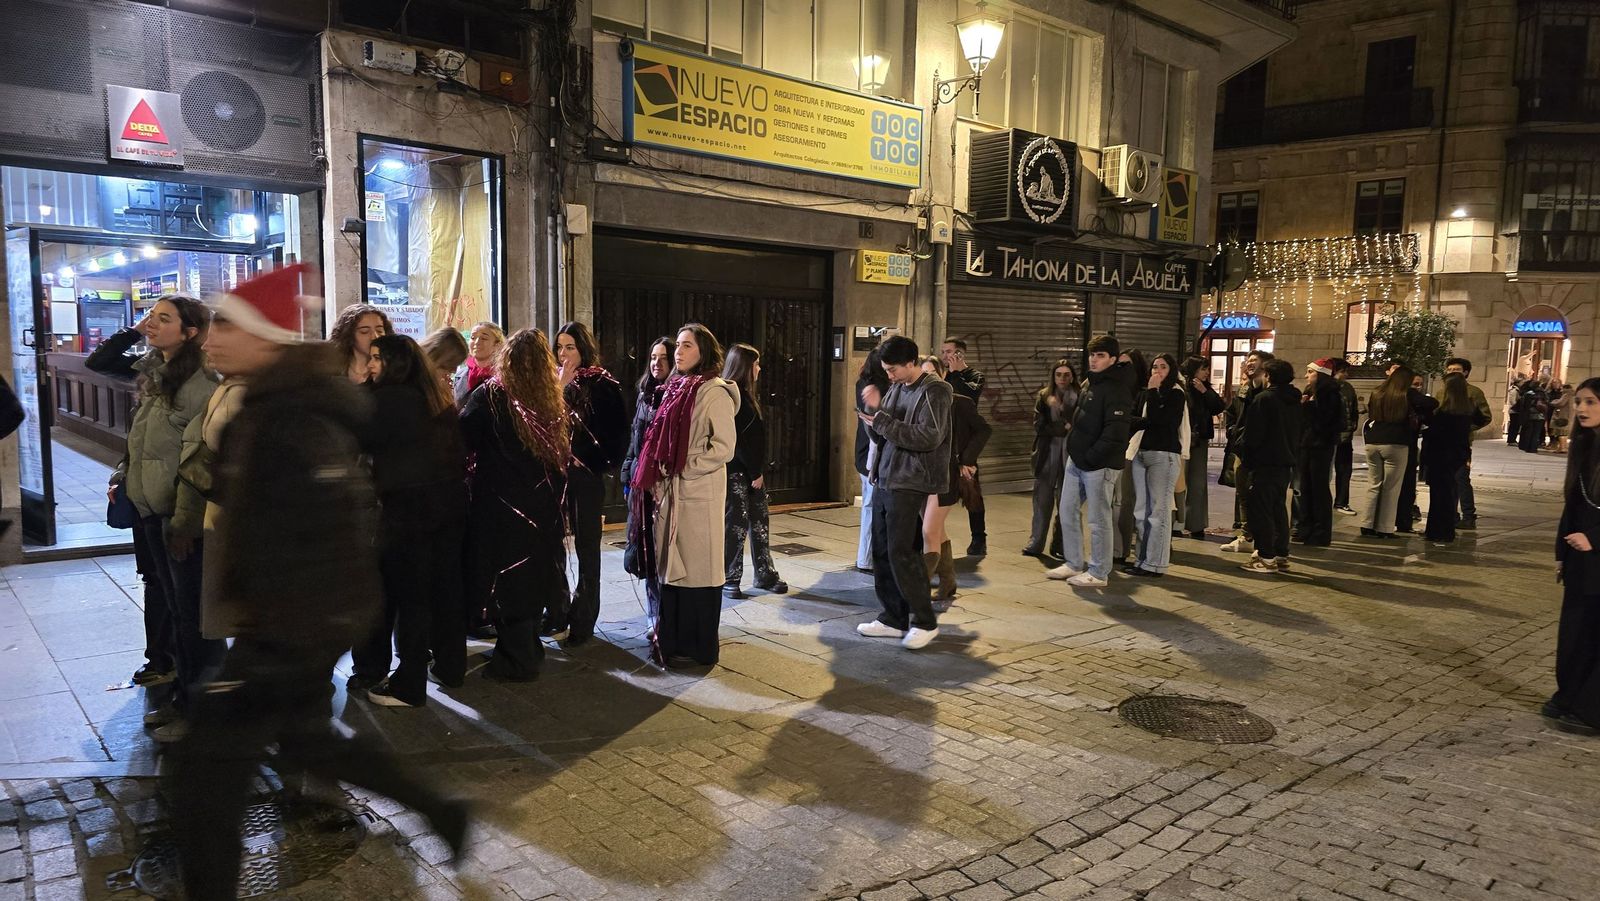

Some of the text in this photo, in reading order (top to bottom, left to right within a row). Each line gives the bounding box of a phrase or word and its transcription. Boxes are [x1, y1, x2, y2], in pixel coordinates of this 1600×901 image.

[681, 68, 768, 112] NUEVO
[774, 89, 865, 115] ARQUITECTURA E INTERIORISMO
[681, 102, 768, 138] ESPACIO
[773, 104, 855, 128] OBRA NUEVA Y REFORMAS
[130, 122, 160, 134] DELTA
[773, 118, 848, 139] GESTIONES E INFORMES
[873, 113, 918, 139] TOC
[647, 128, 747, 151] www.nuevo-espacio.net
[773, 133, 826, 150] ASESORAMIENTO
[873, 139, 918, 163] TOC
[870, 164, 919, 178] INMOBILIARIA
[1164, 218, 1188, 231] NUEVO
[1164, 231, 1187, 241] ESPACIO
[889, 255, 909, 265] TOC
[966, 240, 1190, 293] LA TAHONA DE LA ABUELA
[889, 267, 909, 277] TOC
[1202, 316, 1260, 329] SAONA
[1516, 321, 1564, 332] SAONA
